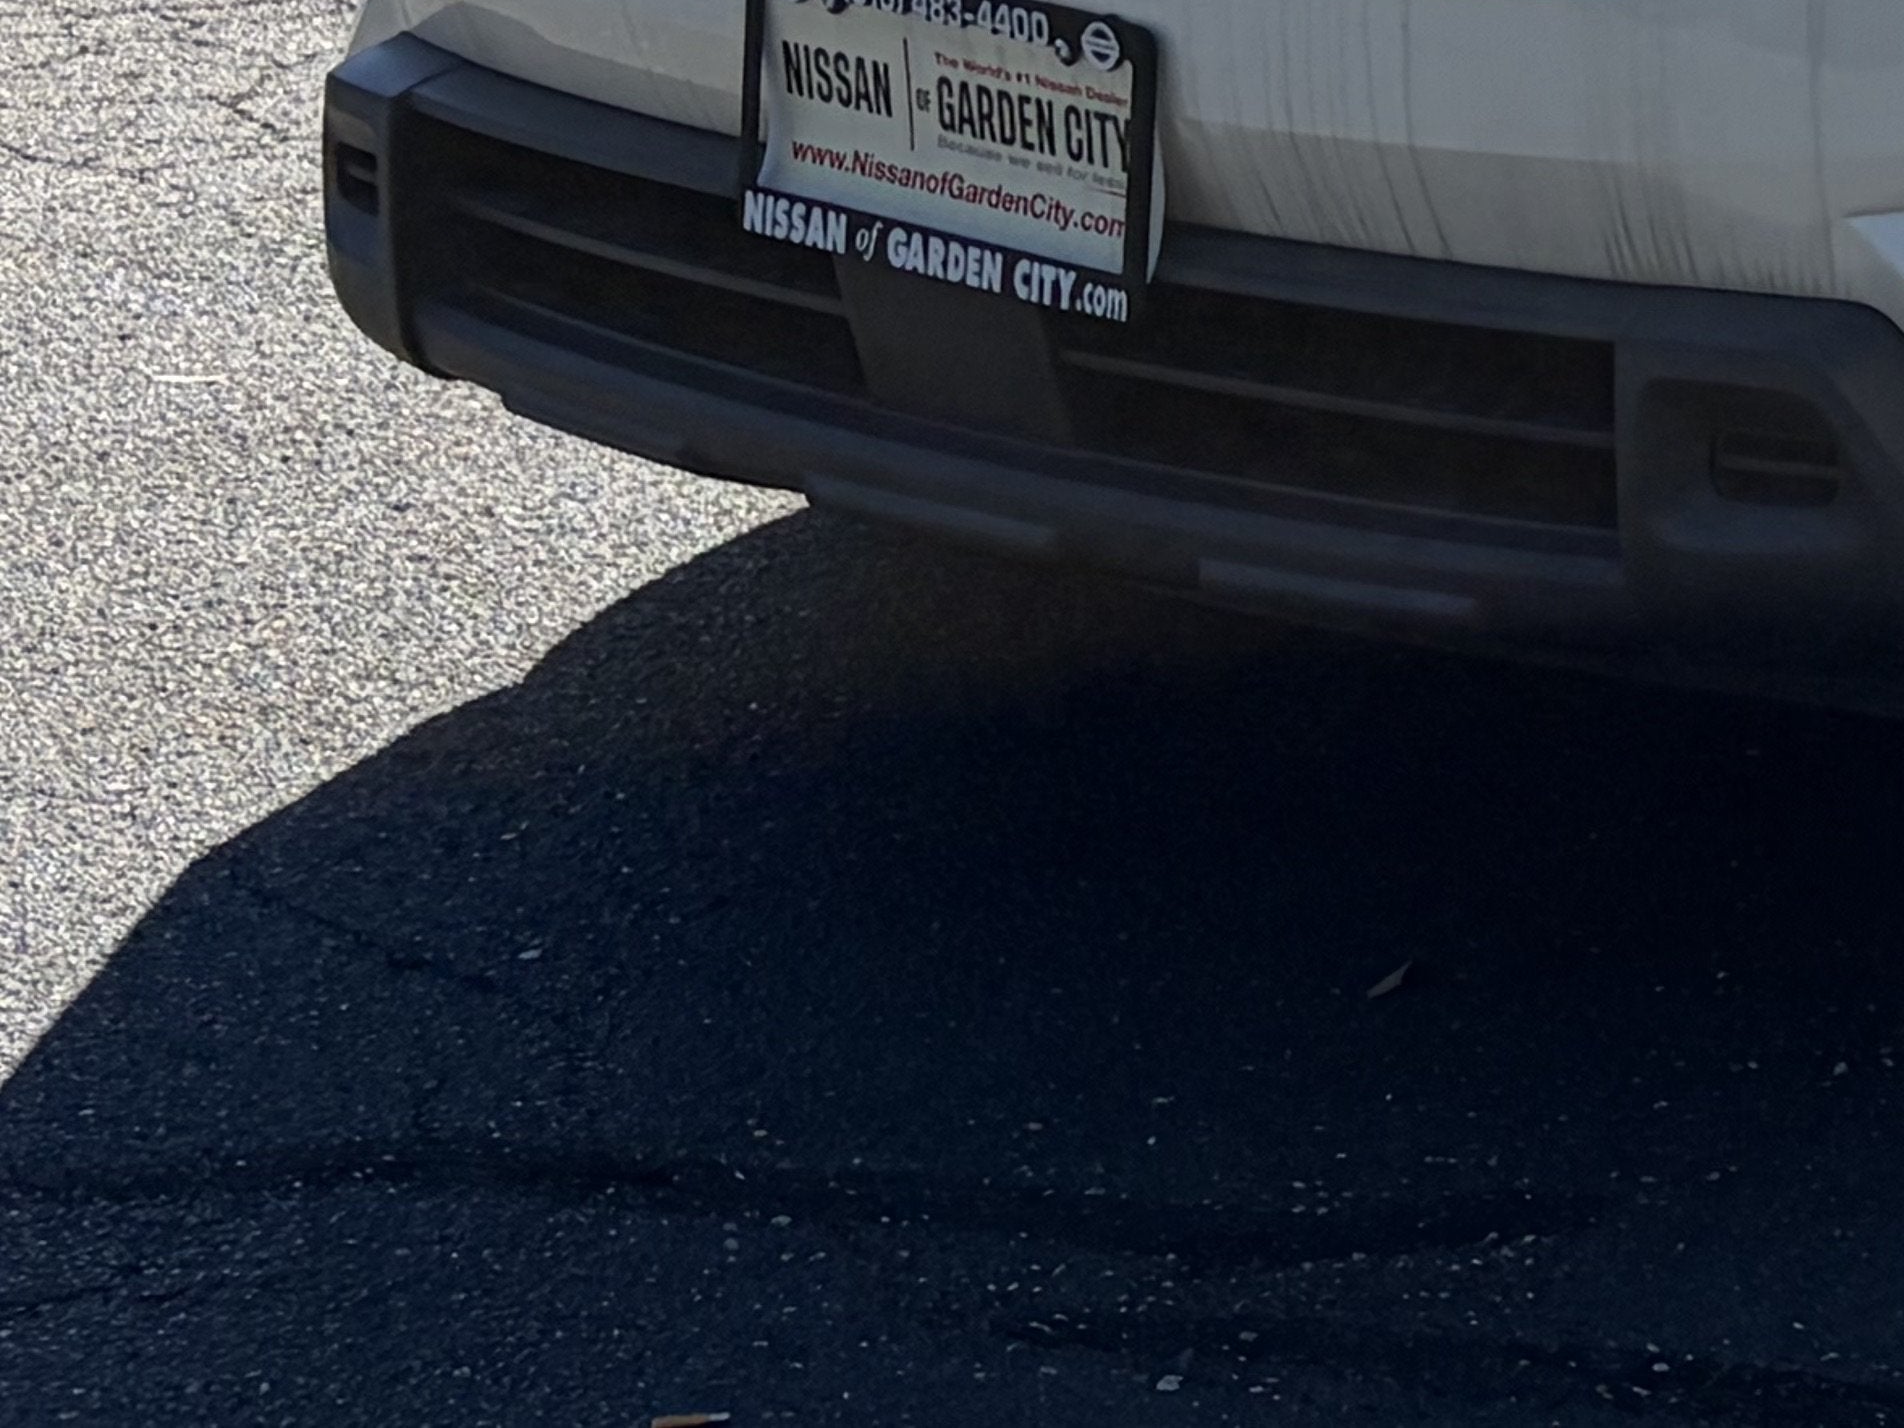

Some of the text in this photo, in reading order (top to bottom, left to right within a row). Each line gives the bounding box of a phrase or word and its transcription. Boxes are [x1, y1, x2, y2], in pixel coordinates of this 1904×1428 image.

[781, 39, 894, 118] NISSAN
[936, 75, 1057, 158] GARDEN
[1064, 104, 1131, 175] CITY
[743, 189, 1129, 323] NISSAN of GARDEN CITY.com
